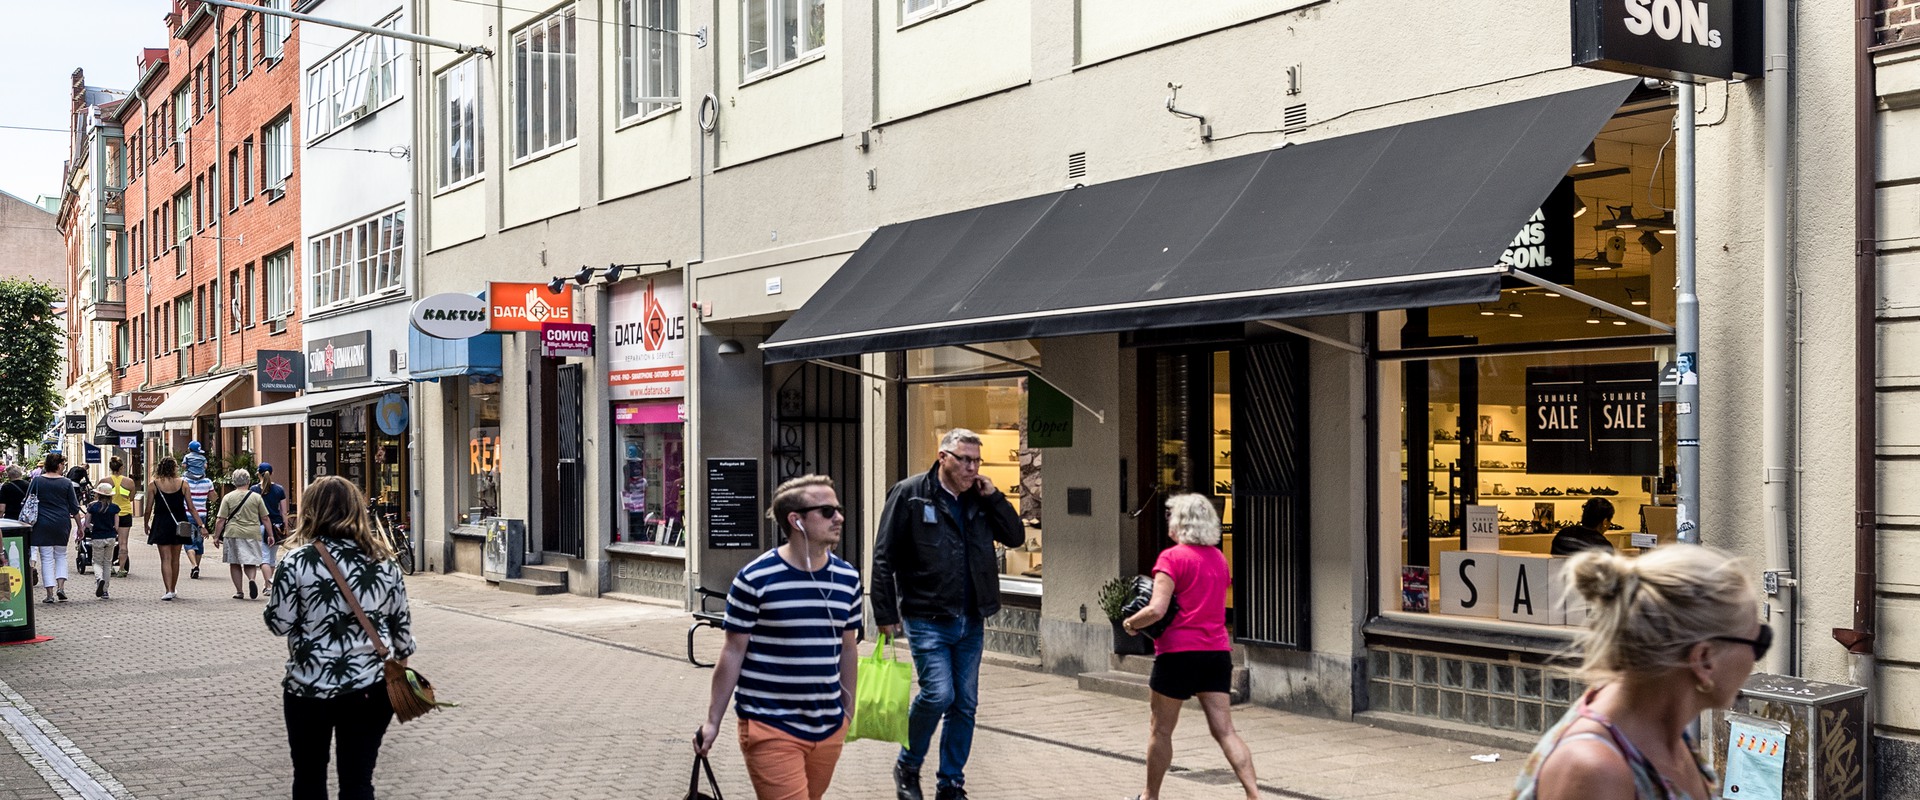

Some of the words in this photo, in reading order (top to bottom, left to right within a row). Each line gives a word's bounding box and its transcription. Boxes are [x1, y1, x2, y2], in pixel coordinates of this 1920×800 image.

[1509, 222, 1546, 247] NS
[422, 308, 486, 322] KAKTUS
[547, 329, 589, 342] COMVIQ
[657, 352, 674, 360] SERVICE
[629, 386, 670, 396] www.datarus.se
[1603, 392, 1646, 401] SUMMER
[1538, 394, 1578, 403] SUMMER
[310, 418, 332, 427] GULD
[1538, 405, 1579, 430] SALE
[1603, 404, 1646, 430] SALE
[1031, 416, 1068, 437] Öppet
[318, 429, 324, 437] &
[310, 439, 333, 448] SILVER
[470, 435, 502, 475] REA
[1472, 522, 1493, 533] SALE
